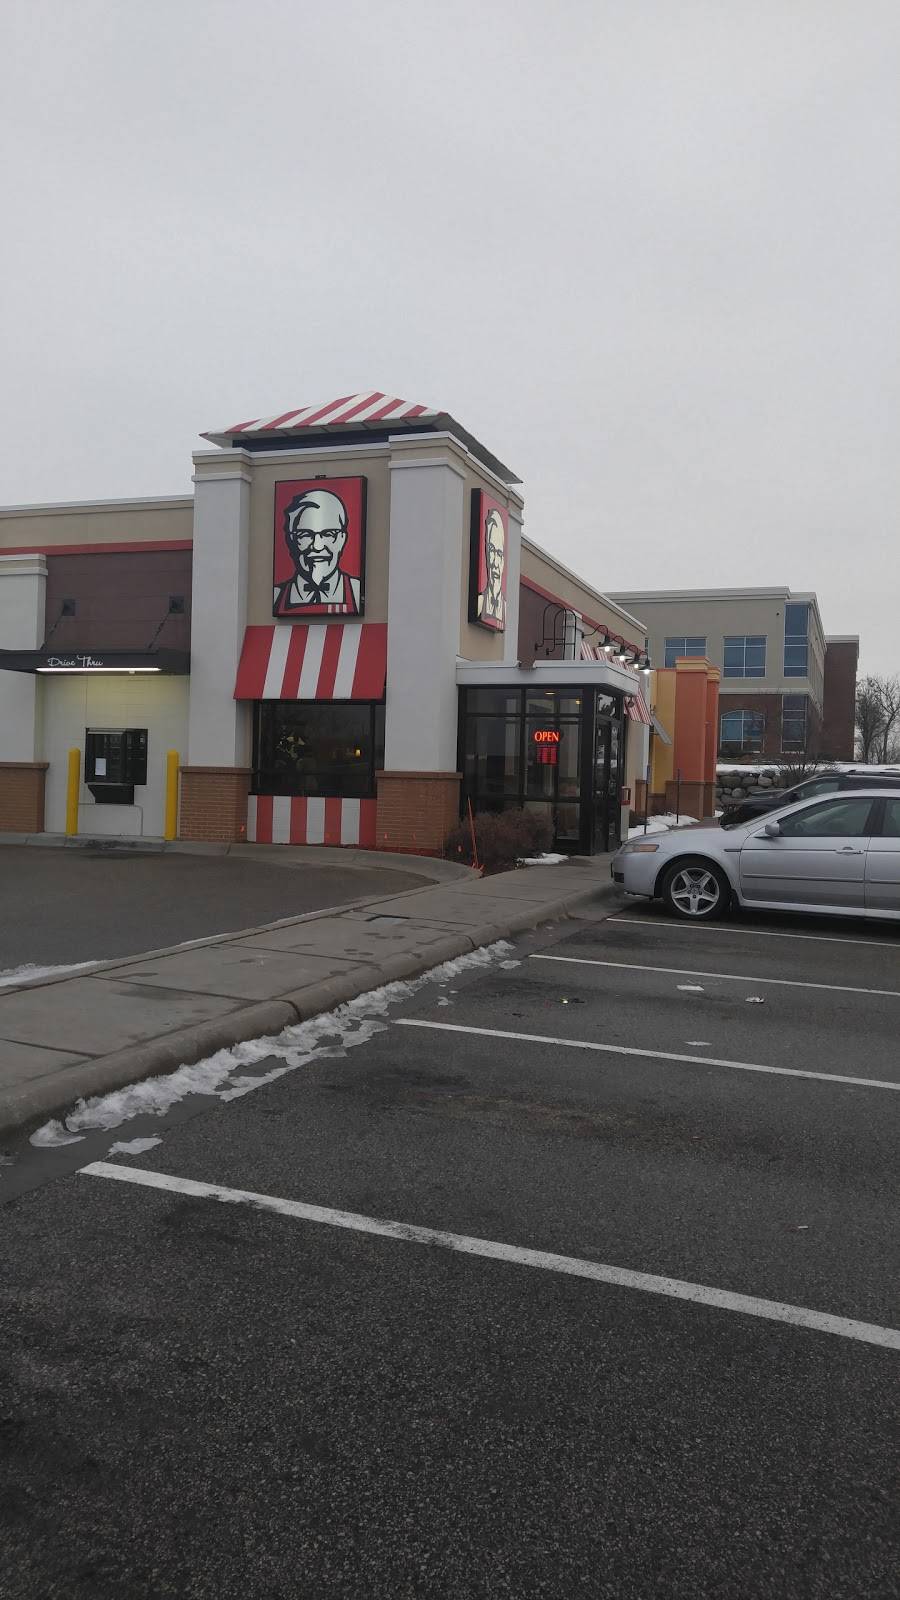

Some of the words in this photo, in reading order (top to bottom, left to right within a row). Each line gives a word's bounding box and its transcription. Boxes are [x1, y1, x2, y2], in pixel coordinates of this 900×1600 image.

[47, 657, 76, 667] Drive
[76, 654, 104, 668] Thru
[534, 731, 560, 742] OPEN
